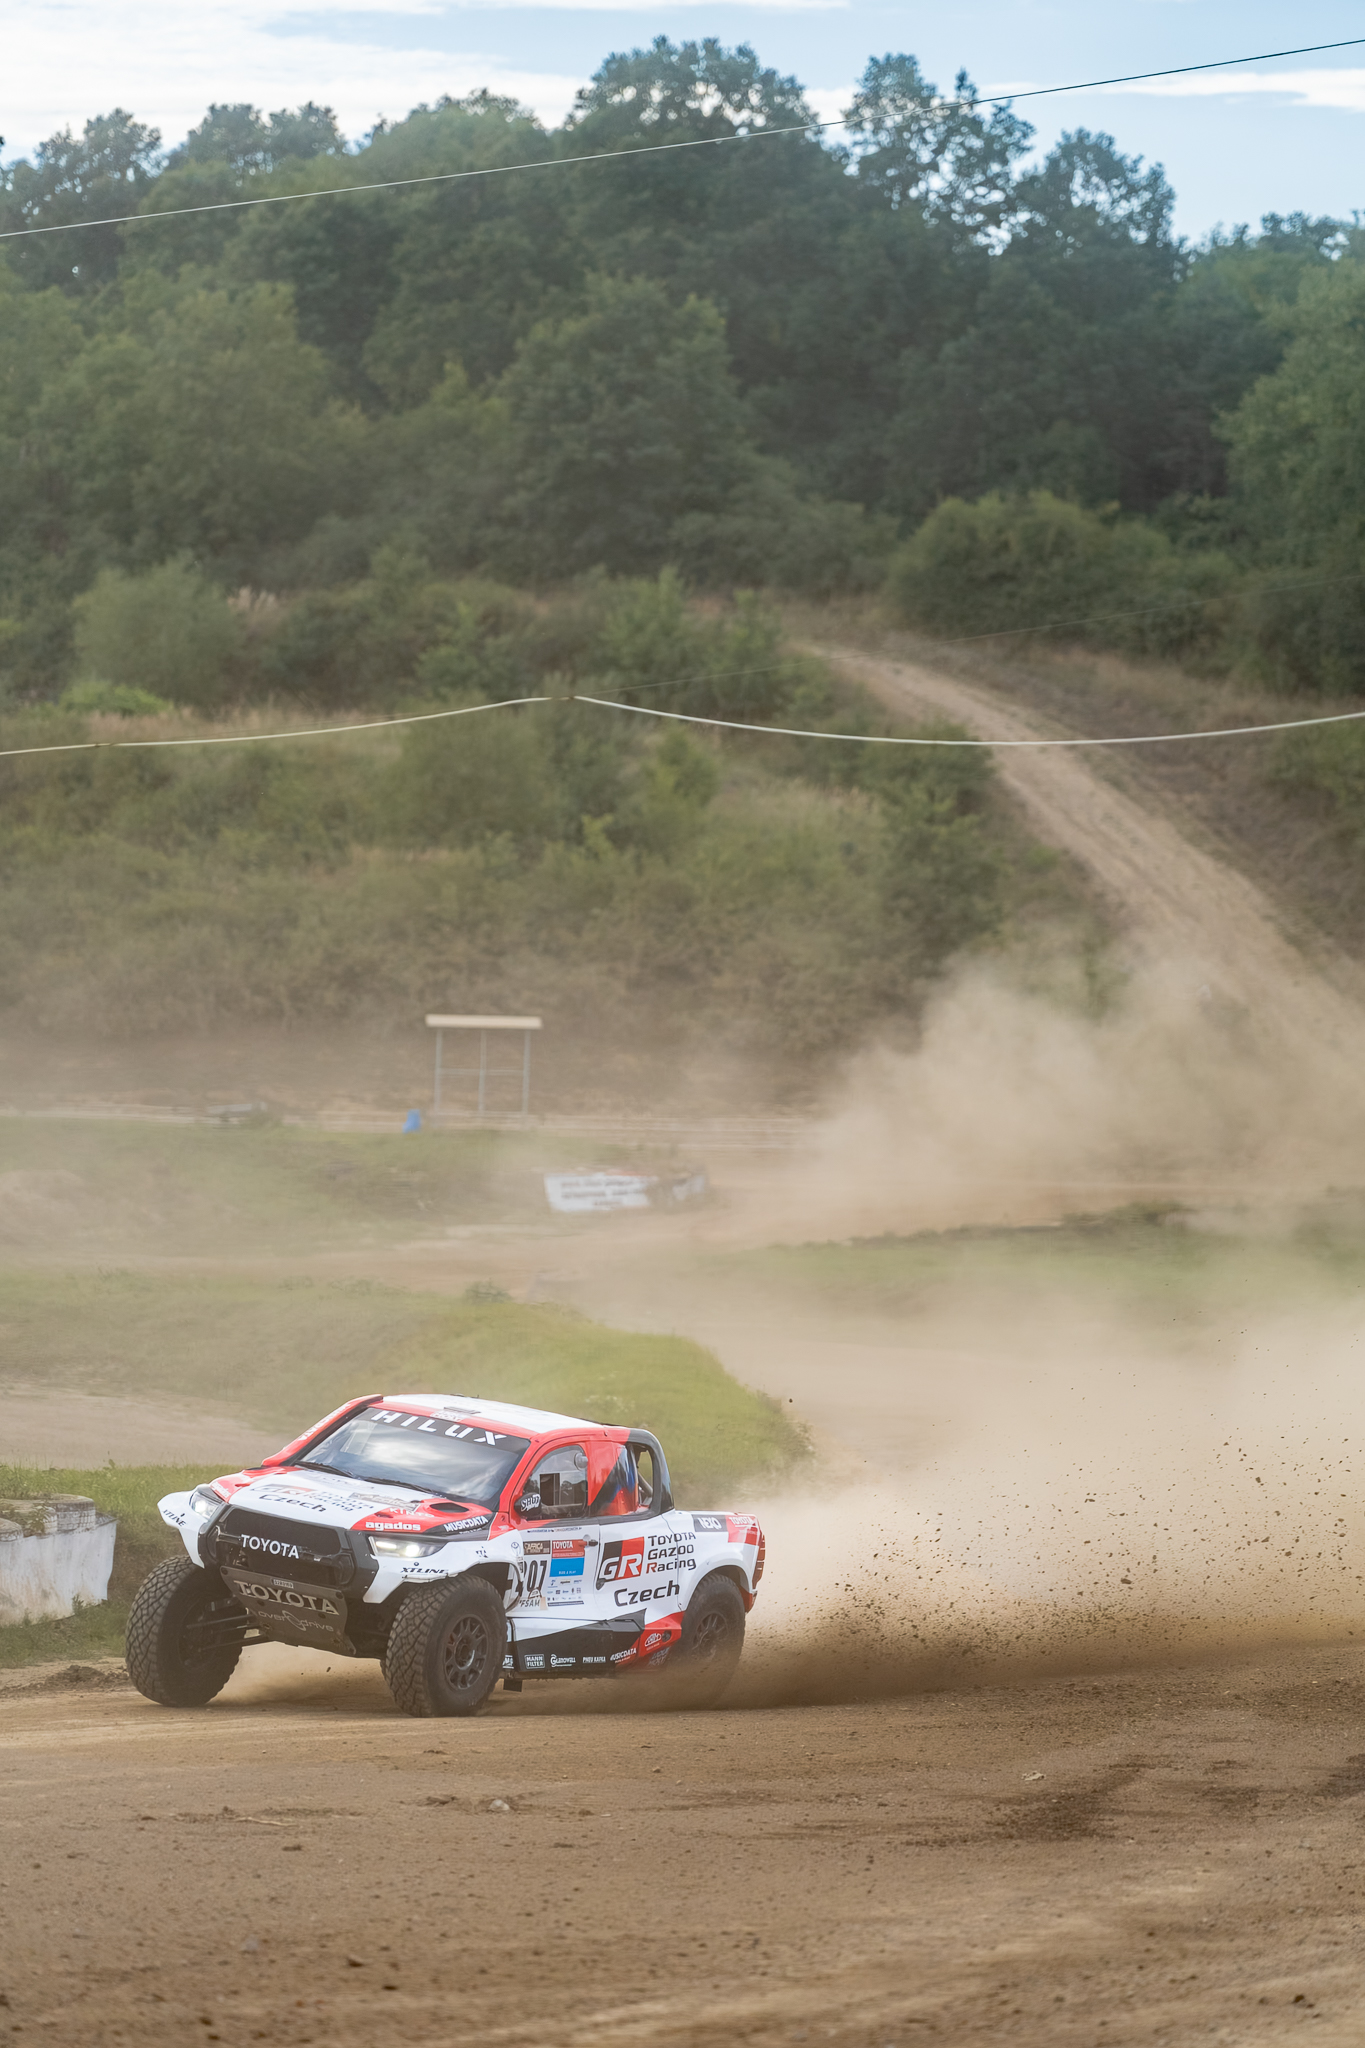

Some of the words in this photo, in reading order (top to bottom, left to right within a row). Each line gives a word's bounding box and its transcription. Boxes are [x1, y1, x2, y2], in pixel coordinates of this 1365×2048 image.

[371, 1410, 507, 1446] HILUX
[259, 1494, 327, 1513] Czech
[365, 1521, 421, 1532] agados
[443, 1515, 489, 1532] MUSICDATA
[241, 1533, 299, 1559] TOYOTA
[553, 1541, 573, 1549] TOYOTA
[648, 1532, 697, 1547] TOYOTA
[648, 1545, 694, 1560] GAZOO
[599, 1553, 643, 1580] GR
[646, 1558, 697, 1574] Racing
[234, 1580, 339, 1615] TOYOTA
[614, 1580, 680, 1607] Czech
